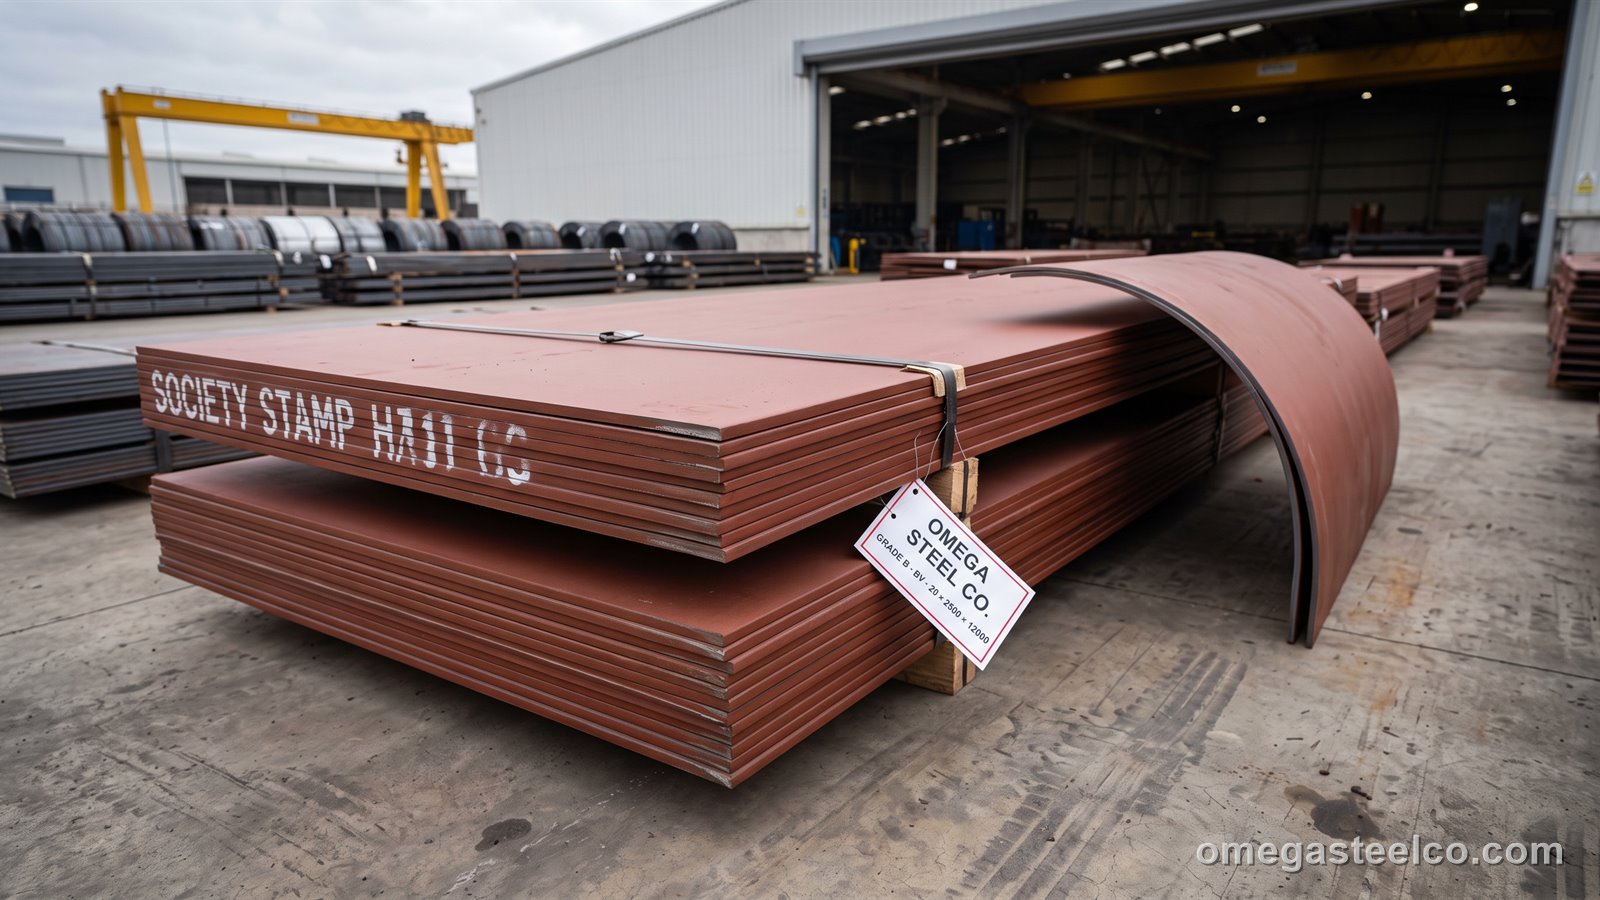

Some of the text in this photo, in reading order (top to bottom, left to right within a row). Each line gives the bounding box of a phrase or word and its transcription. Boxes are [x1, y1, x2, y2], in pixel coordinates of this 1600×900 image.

[152, 369, 247, 430] SOCIETY
[259, 387, 354, 450] STAMP
[876, 533, 904, 562] GRADE
[902, 559, 910, 568] B
[913, 569, 926, 582] BV
[928, 584, 939, 596] 20
[943, 599, 962, 618] 2500
[968, 622, 990, 644] 12000
[906, 529, 989, 618] STEEL CO.
[928, 518, 989, 584] OMEGA
